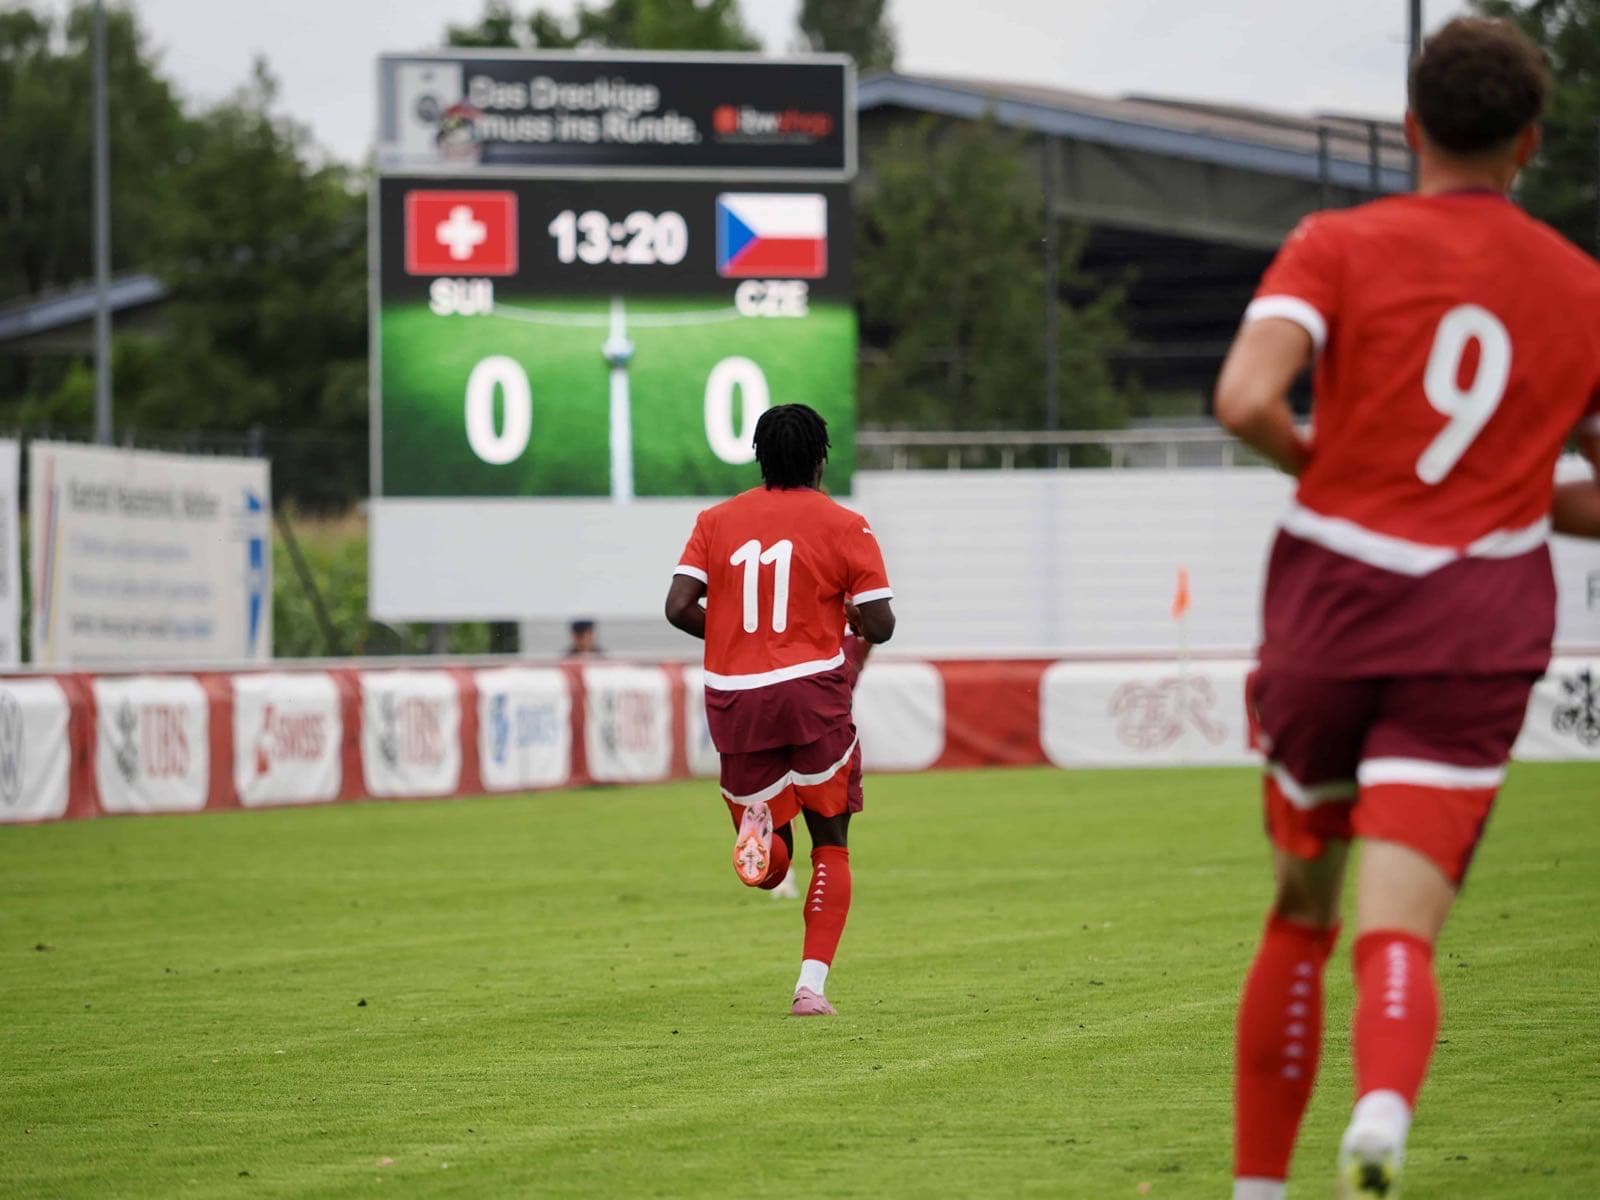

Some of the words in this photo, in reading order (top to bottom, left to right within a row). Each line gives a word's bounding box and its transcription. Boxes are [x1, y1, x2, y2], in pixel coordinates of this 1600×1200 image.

[470, 76, 527, 109] Das
[530, 77, 660, 119] Dreckige
[476, 115, 553, 142] muss
[556, 111, 601, 142] ins
[548, 210, 687, 264] 13:20
[429, 279, 494, 315] SUI
[735, 281, 809, 317] CZE
[465, 356, 532, 465] 0
[704, 356, 770, 465] 0
[1415, 303, 1513, 486] 9
[730, 539, 793, 633] 11
